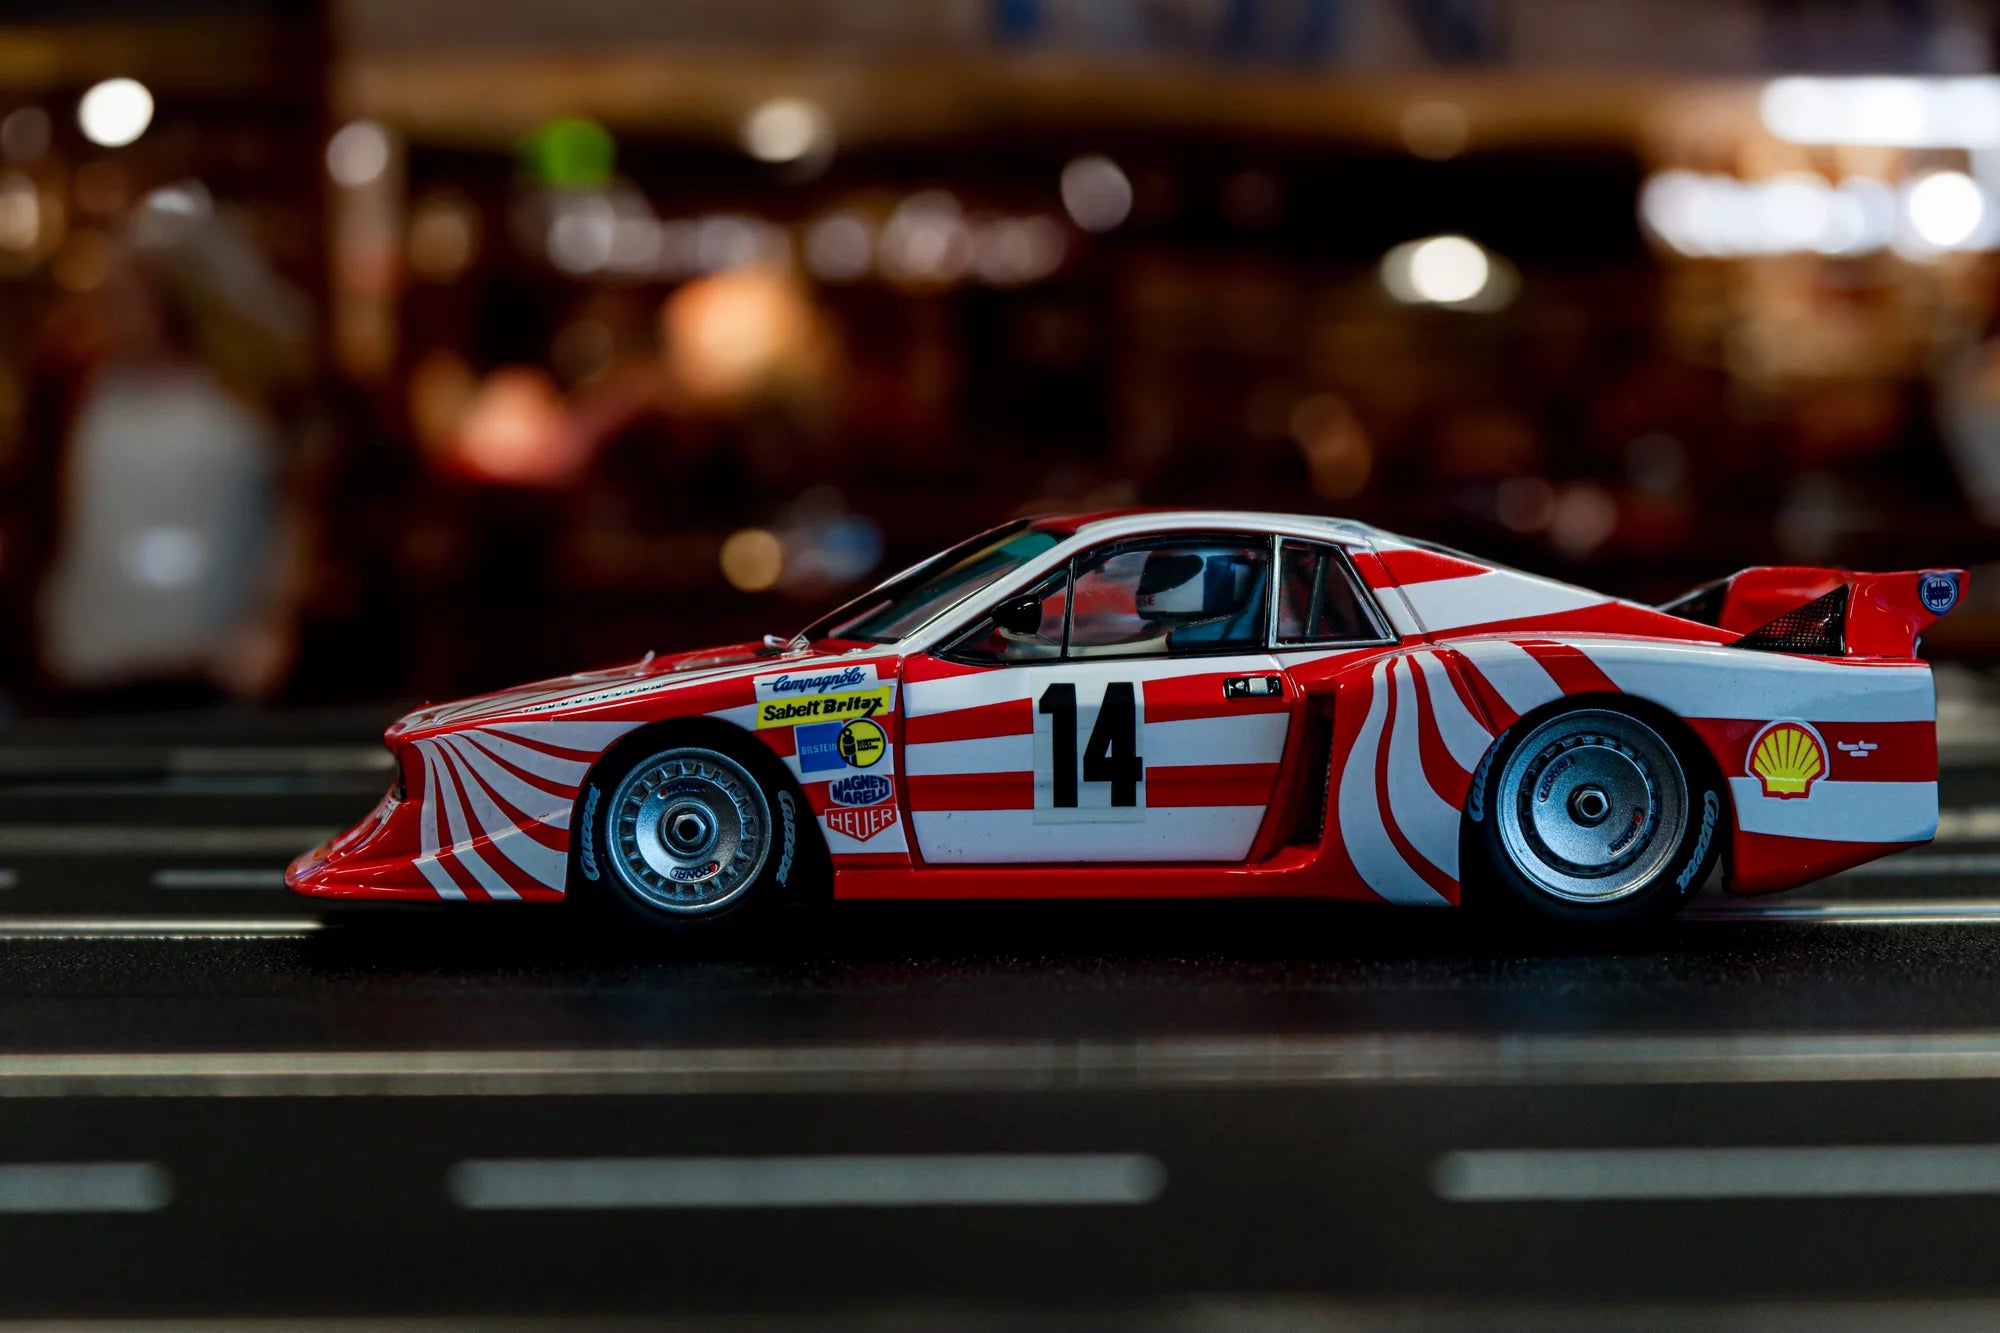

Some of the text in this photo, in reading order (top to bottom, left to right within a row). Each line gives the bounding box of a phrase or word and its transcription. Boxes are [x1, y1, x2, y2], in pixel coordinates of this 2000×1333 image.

[762, 667, 866, 693] Campagnolo
[763, 696, 883, 721] Sabelt Britax
[801, 743, 838, 755] BILSTEIN
[1039, 682, 1143, 808] 14
[831, 809, 892, 839] HEUER
